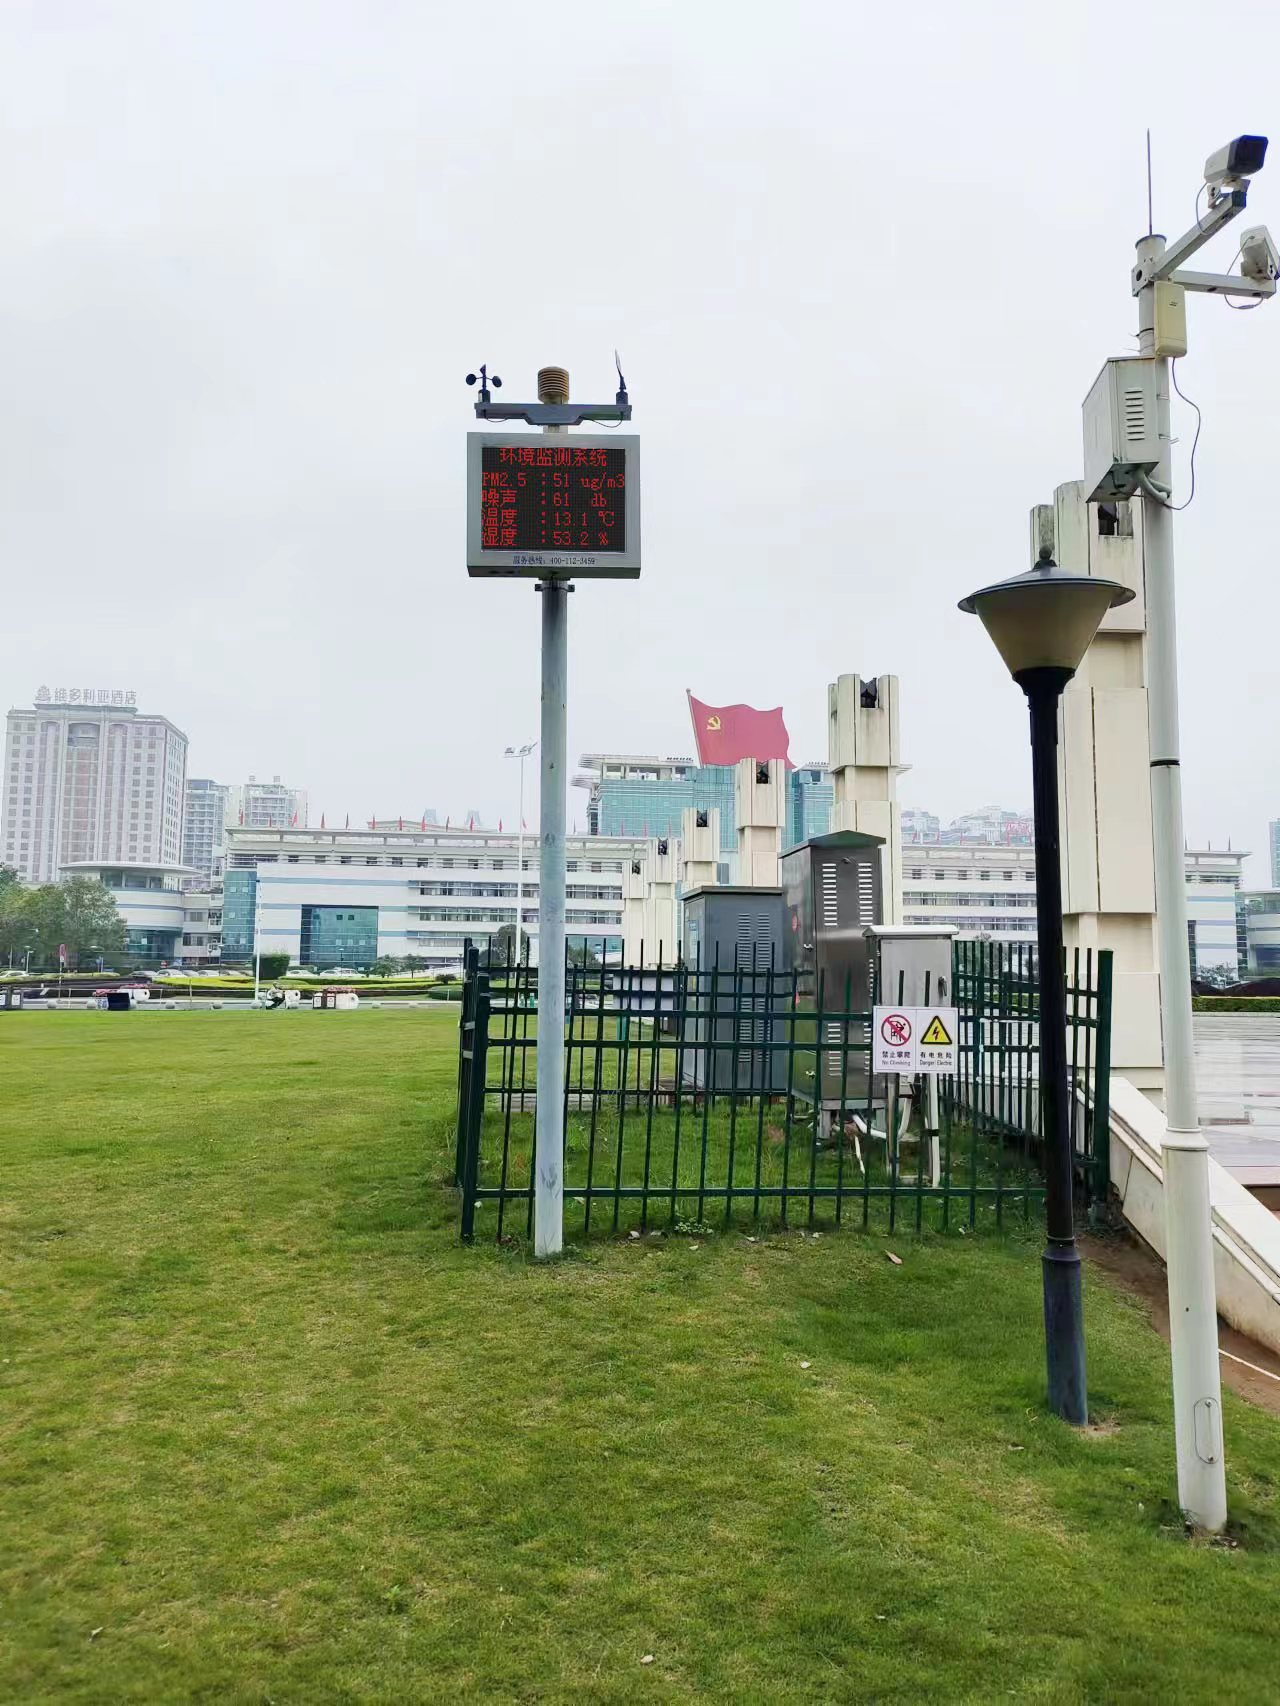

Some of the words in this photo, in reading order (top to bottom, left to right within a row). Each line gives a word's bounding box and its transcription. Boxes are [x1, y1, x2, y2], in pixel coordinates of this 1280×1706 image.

[499, 447, 607, 467] 环境监测系统
[482, 472, 527, 487] PM2.5
[580, 471, 625, 490] ug/m3
[482, 488, 517, 508] 噪声
[591, 492, 607, 507] db
[482, 508, 518, 527] 温度
[482, 527, 518, 547] 湿度
[598, 531, 609, 545] %
[54, 687, 137, 705] 维多利亚酒店
[882, 1051, 911, 1059] 禁止攀爬
[920, 1051, 953, 1059] 有电危险
